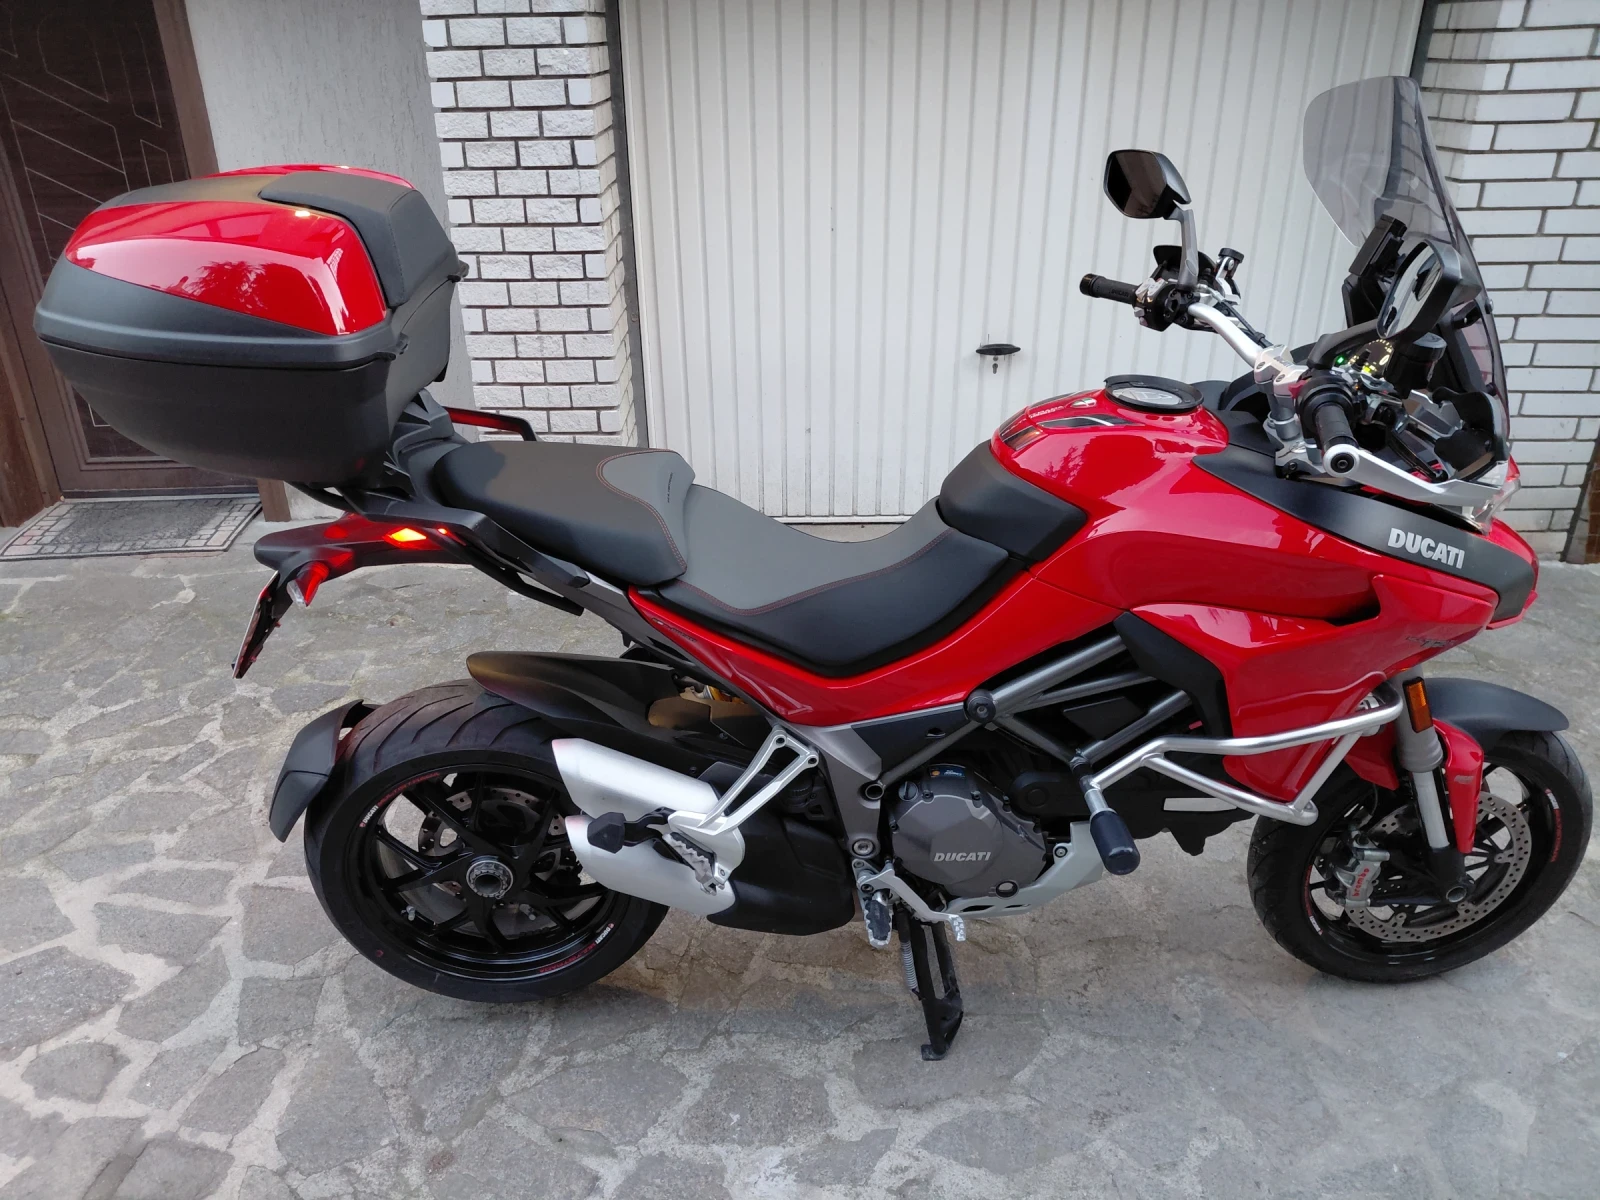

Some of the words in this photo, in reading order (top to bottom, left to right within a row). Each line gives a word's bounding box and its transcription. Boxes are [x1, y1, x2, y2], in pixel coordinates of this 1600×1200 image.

[1388, 528, 1465, 569] DUCATI
[363, 804, 379, 823] DUCATI
[934, 852, 991, 862] DUCATI
[1352, 867, 1370, 897] brembo
[595, 926, 612, 944] DUCATI
